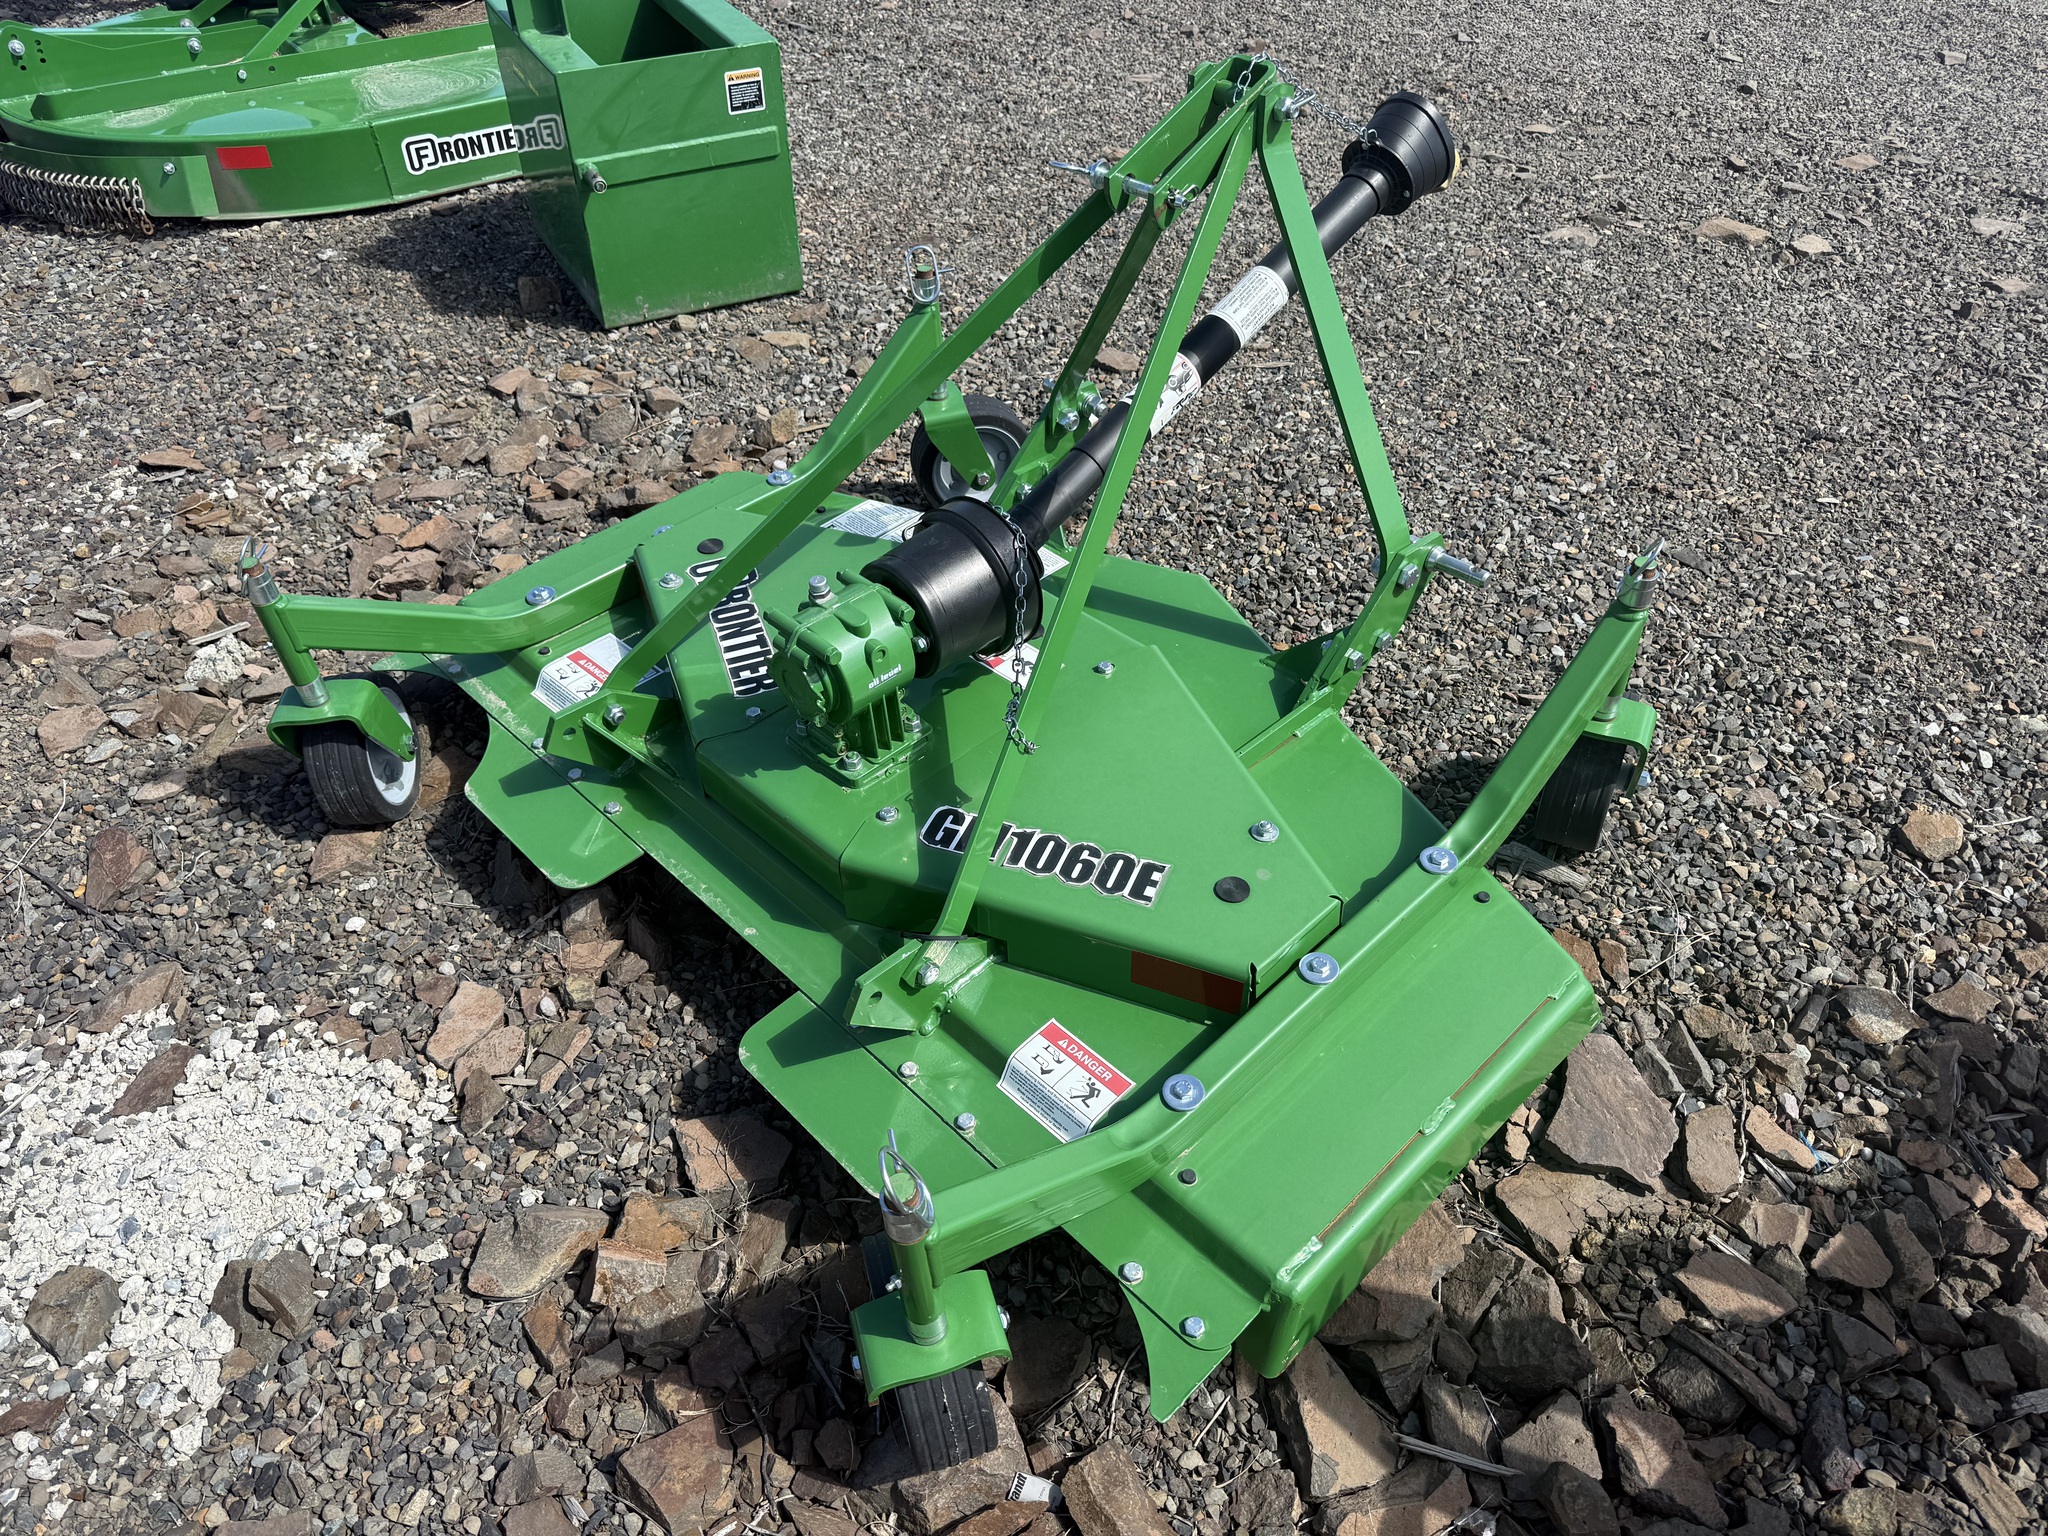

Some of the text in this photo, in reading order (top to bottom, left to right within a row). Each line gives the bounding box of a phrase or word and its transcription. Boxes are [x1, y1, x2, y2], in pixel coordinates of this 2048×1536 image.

[735, 72, 760, 80] WARNING
[405, 128, 516, 172] FRONTIE
[688, 558, 778, 695] RONTIER
[585, 660, 608, 680] DANGE
[1067, 1044, 1113, 1082] DANGER
[1009, 1473, 1028, 1501] randt
